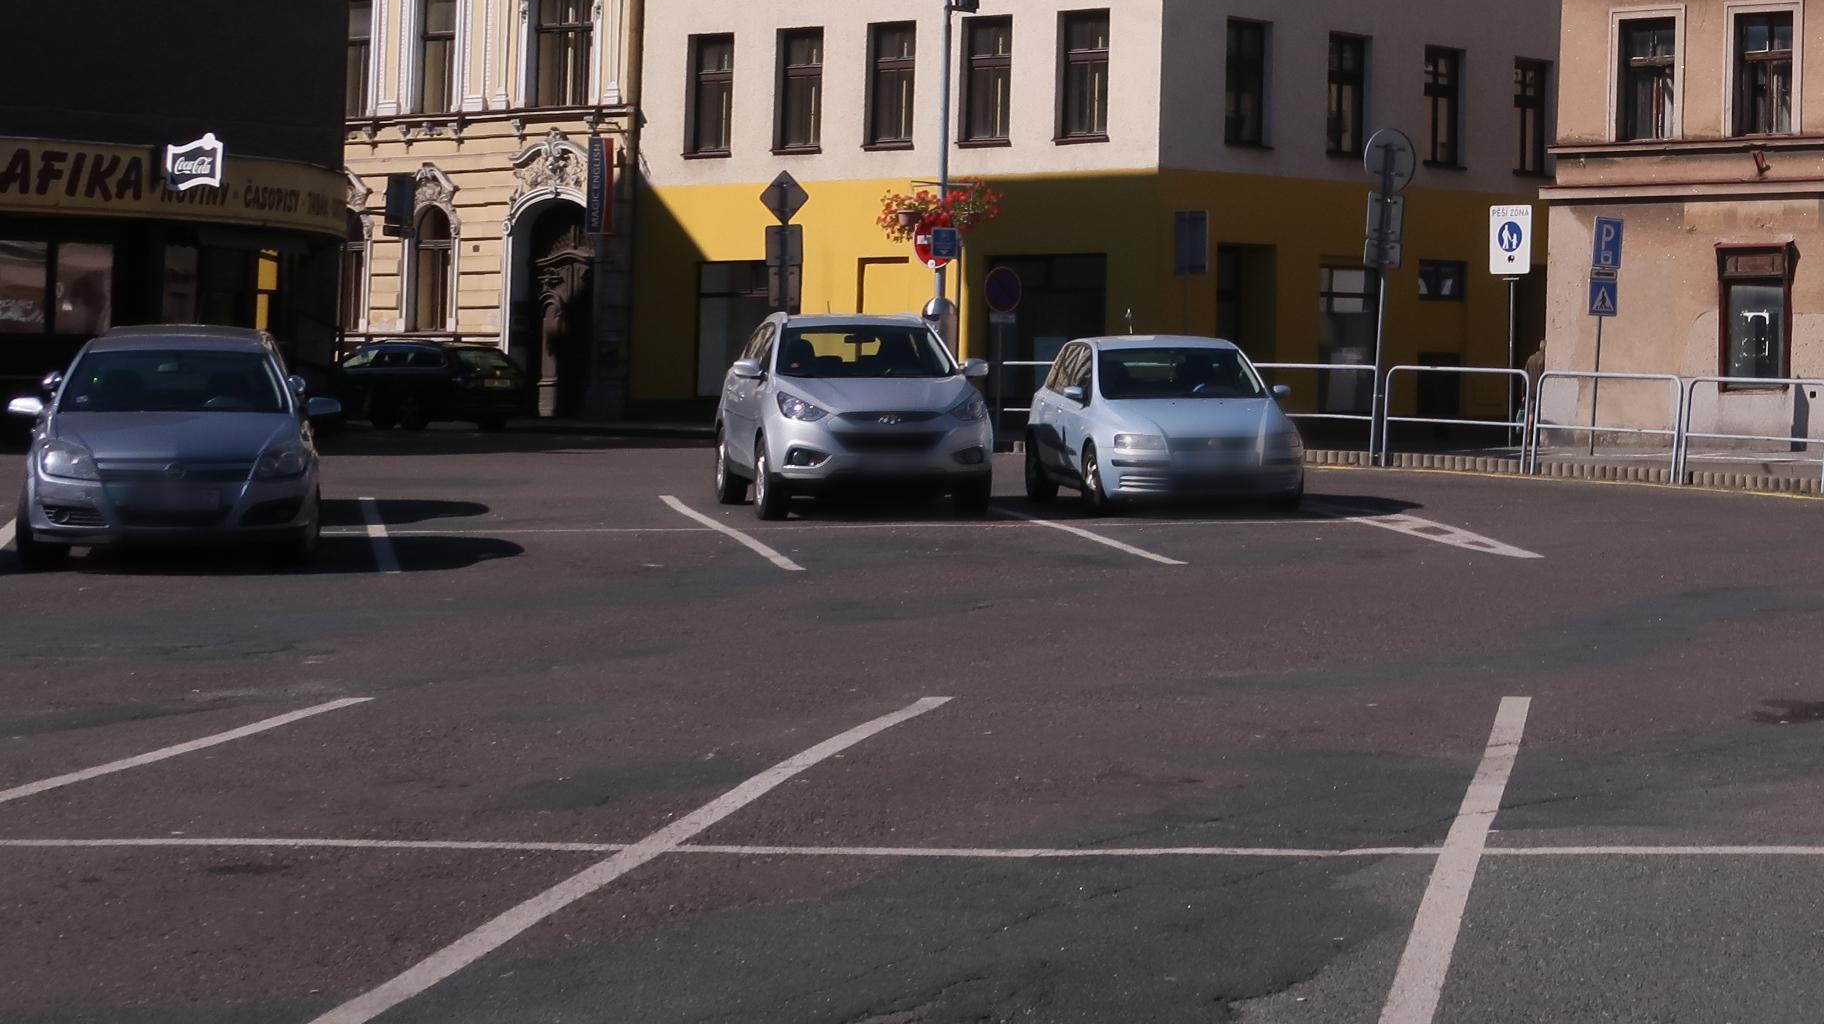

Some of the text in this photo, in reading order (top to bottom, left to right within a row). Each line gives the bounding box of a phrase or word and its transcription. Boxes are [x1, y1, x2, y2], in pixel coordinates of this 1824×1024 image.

[0, 148, 143, 203] AFIKA
[591, 144, 601, 227] MAGIC ENGLISH
[244, 180, 301, 214] ČASOPISY
[1491, 207, 1529, 217] PĚŠÍ ZÓNA
[1602, 224, 1615, 251] P
